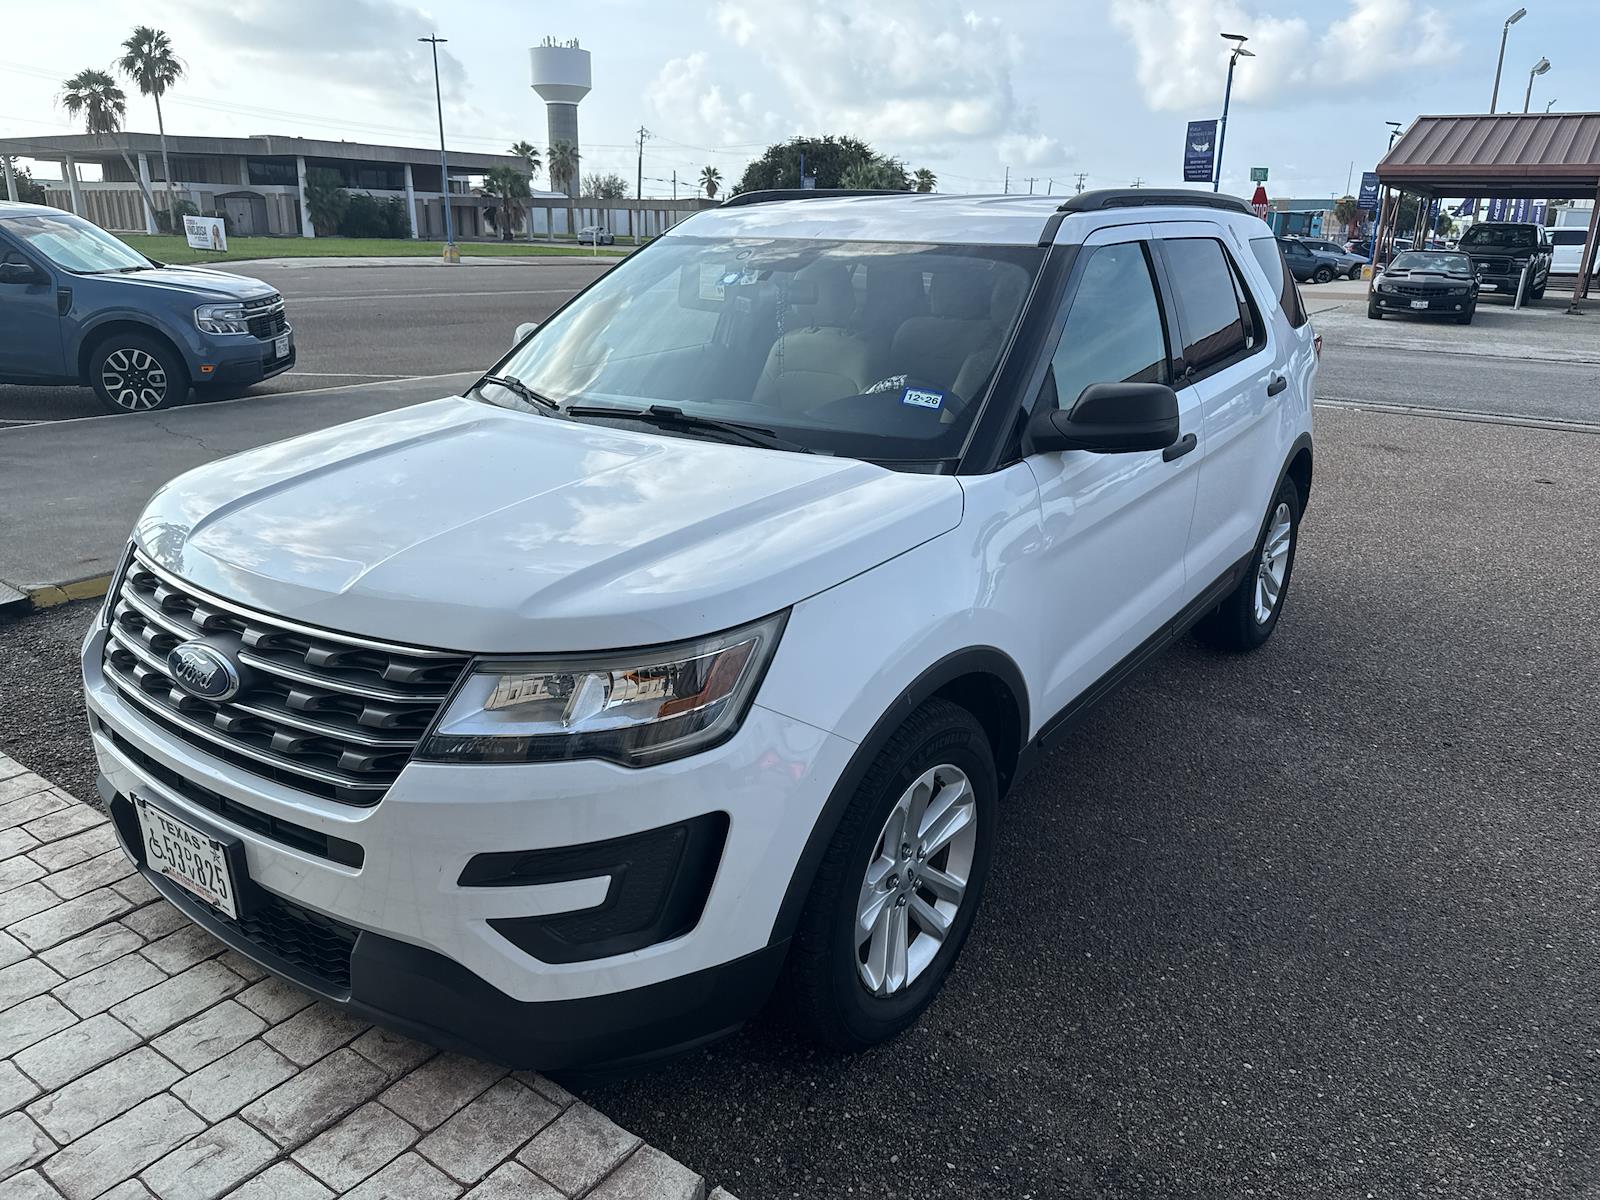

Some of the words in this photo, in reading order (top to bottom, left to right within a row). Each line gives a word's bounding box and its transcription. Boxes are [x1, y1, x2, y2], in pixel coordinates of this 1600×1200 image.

[908, 393, 939, 405] 12-26
[176, 652, 218, 689] Ford
[158, 816, 201, 850] TEXAS
